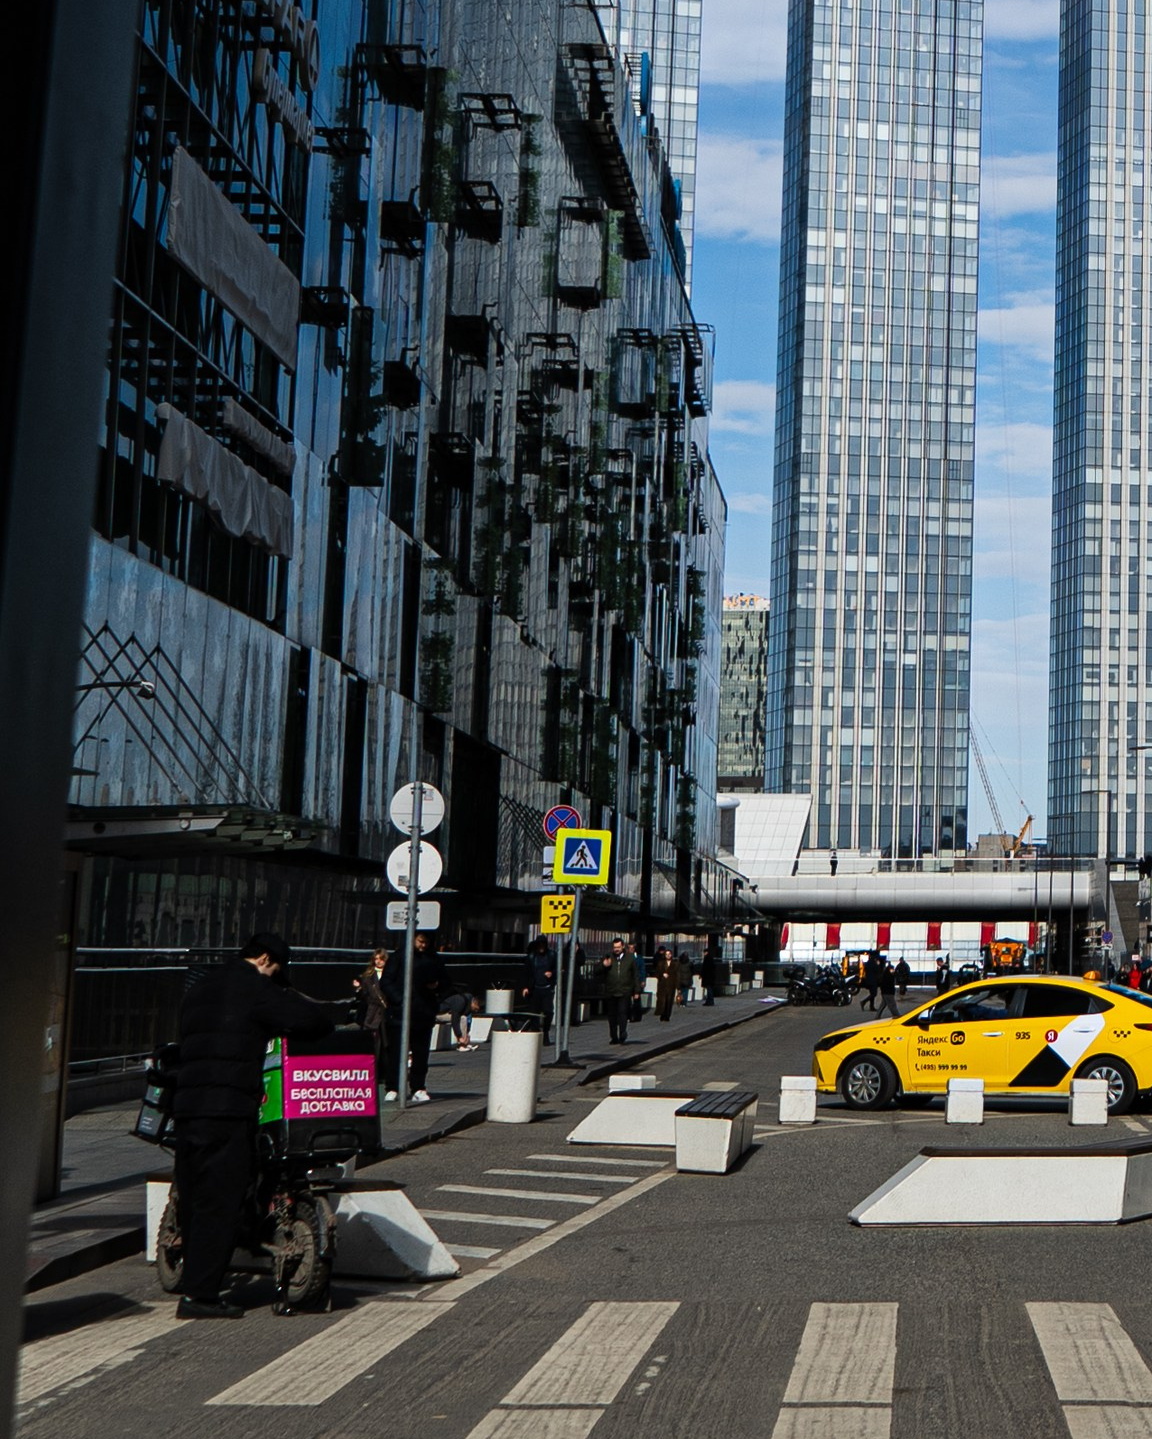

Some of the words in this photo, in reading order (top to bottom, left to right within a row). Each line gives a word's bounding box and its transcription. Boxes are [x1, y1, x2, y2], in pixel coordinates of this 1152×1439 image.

[917, 1035, 948, 1045] Яндекс
[951, 1032, 965, 1044] Go
[1015, 1031, 1031, 1040] 935
[917, 1048, 941, 1057] Такси
[293, 1070, 369, 1082] ВКУСВИЛЛ
